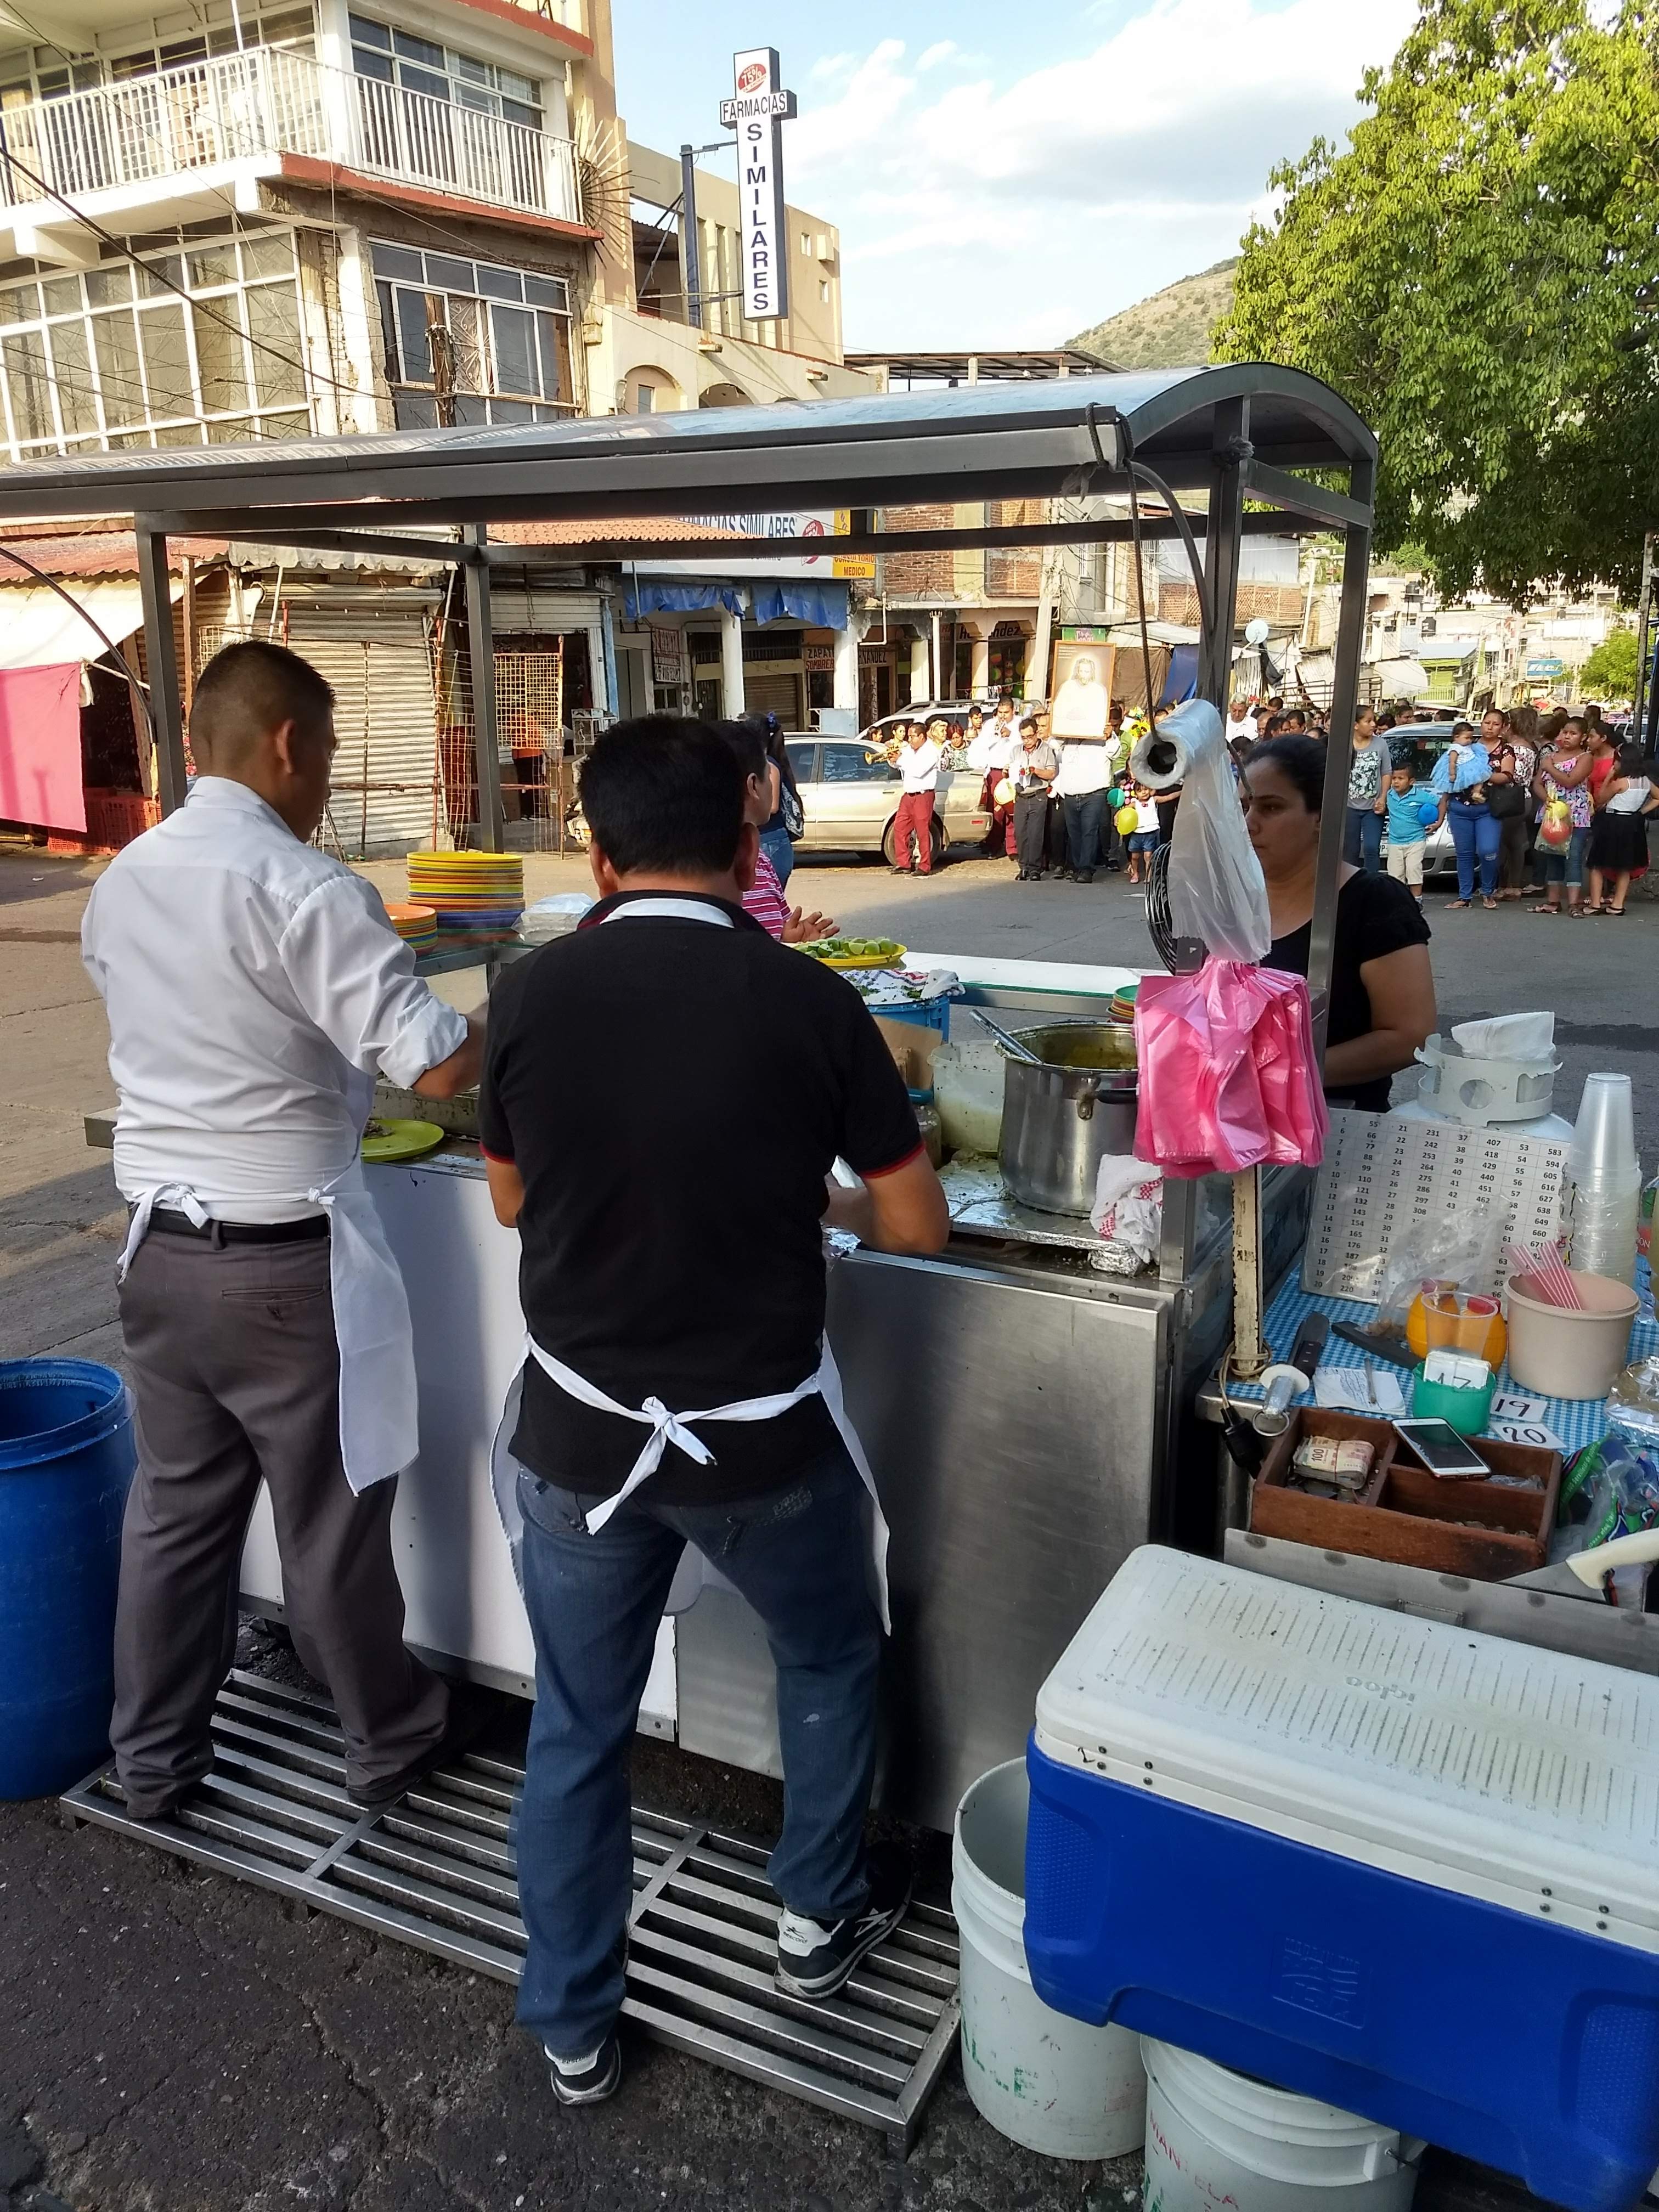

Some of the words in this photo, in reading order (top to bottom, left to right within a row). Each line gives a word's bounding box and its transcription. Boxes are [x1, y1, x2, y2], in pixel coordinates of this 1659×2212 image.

[741, 66, 763, 87] 75%
[723, 93, 786, 120] FARMACIAS
[746, 123, 769, 311] SIMILARES
[843, 567, 866, 576] MEDICO
[1424, 1141, 1438, 1149] 242
[1484, 1150, 1499, 1159] 418
[1545, 1160, 1560, 1169] 594
[1426, 1129, 1440, 1137] 231
[1548, 1148, 1562, 1156] 583
[1420, 1163, 1434, 1171] 264
[1541, 1183, 1555, 1192] 616
[1422, 1152, 1436, 1160] 253
[1482, 1162, 1497, 1170] 429
[1543, 1172, 1558, 1180] 605
[1358, 1175, 1372, 1183] 110
[1537, 1206, 1551, 1215] 638
[1418, 1174, 1432, 1182] 275
[1478, 1184, 1492, 1193] 451
[1539, 1195, 1554, 1203] 627
[1355, 1197, 1368, 1205] 132
[1413, 1207, 1427, 1215] 308
[1532, 1229, 1547, 1238] 660
[1357, 1186, 1369, 1194] 121
[1414, 1196, 1429, 1204] 297
[1534, 1218, 1549, 1226] 649
[1637, 1237, 1650, 1248] ON
[1494, 1398, 1531, 1418] 19
[1502, 1426, 1547, 1444] 20
[1311, 1448, 1324, 1462] 100
